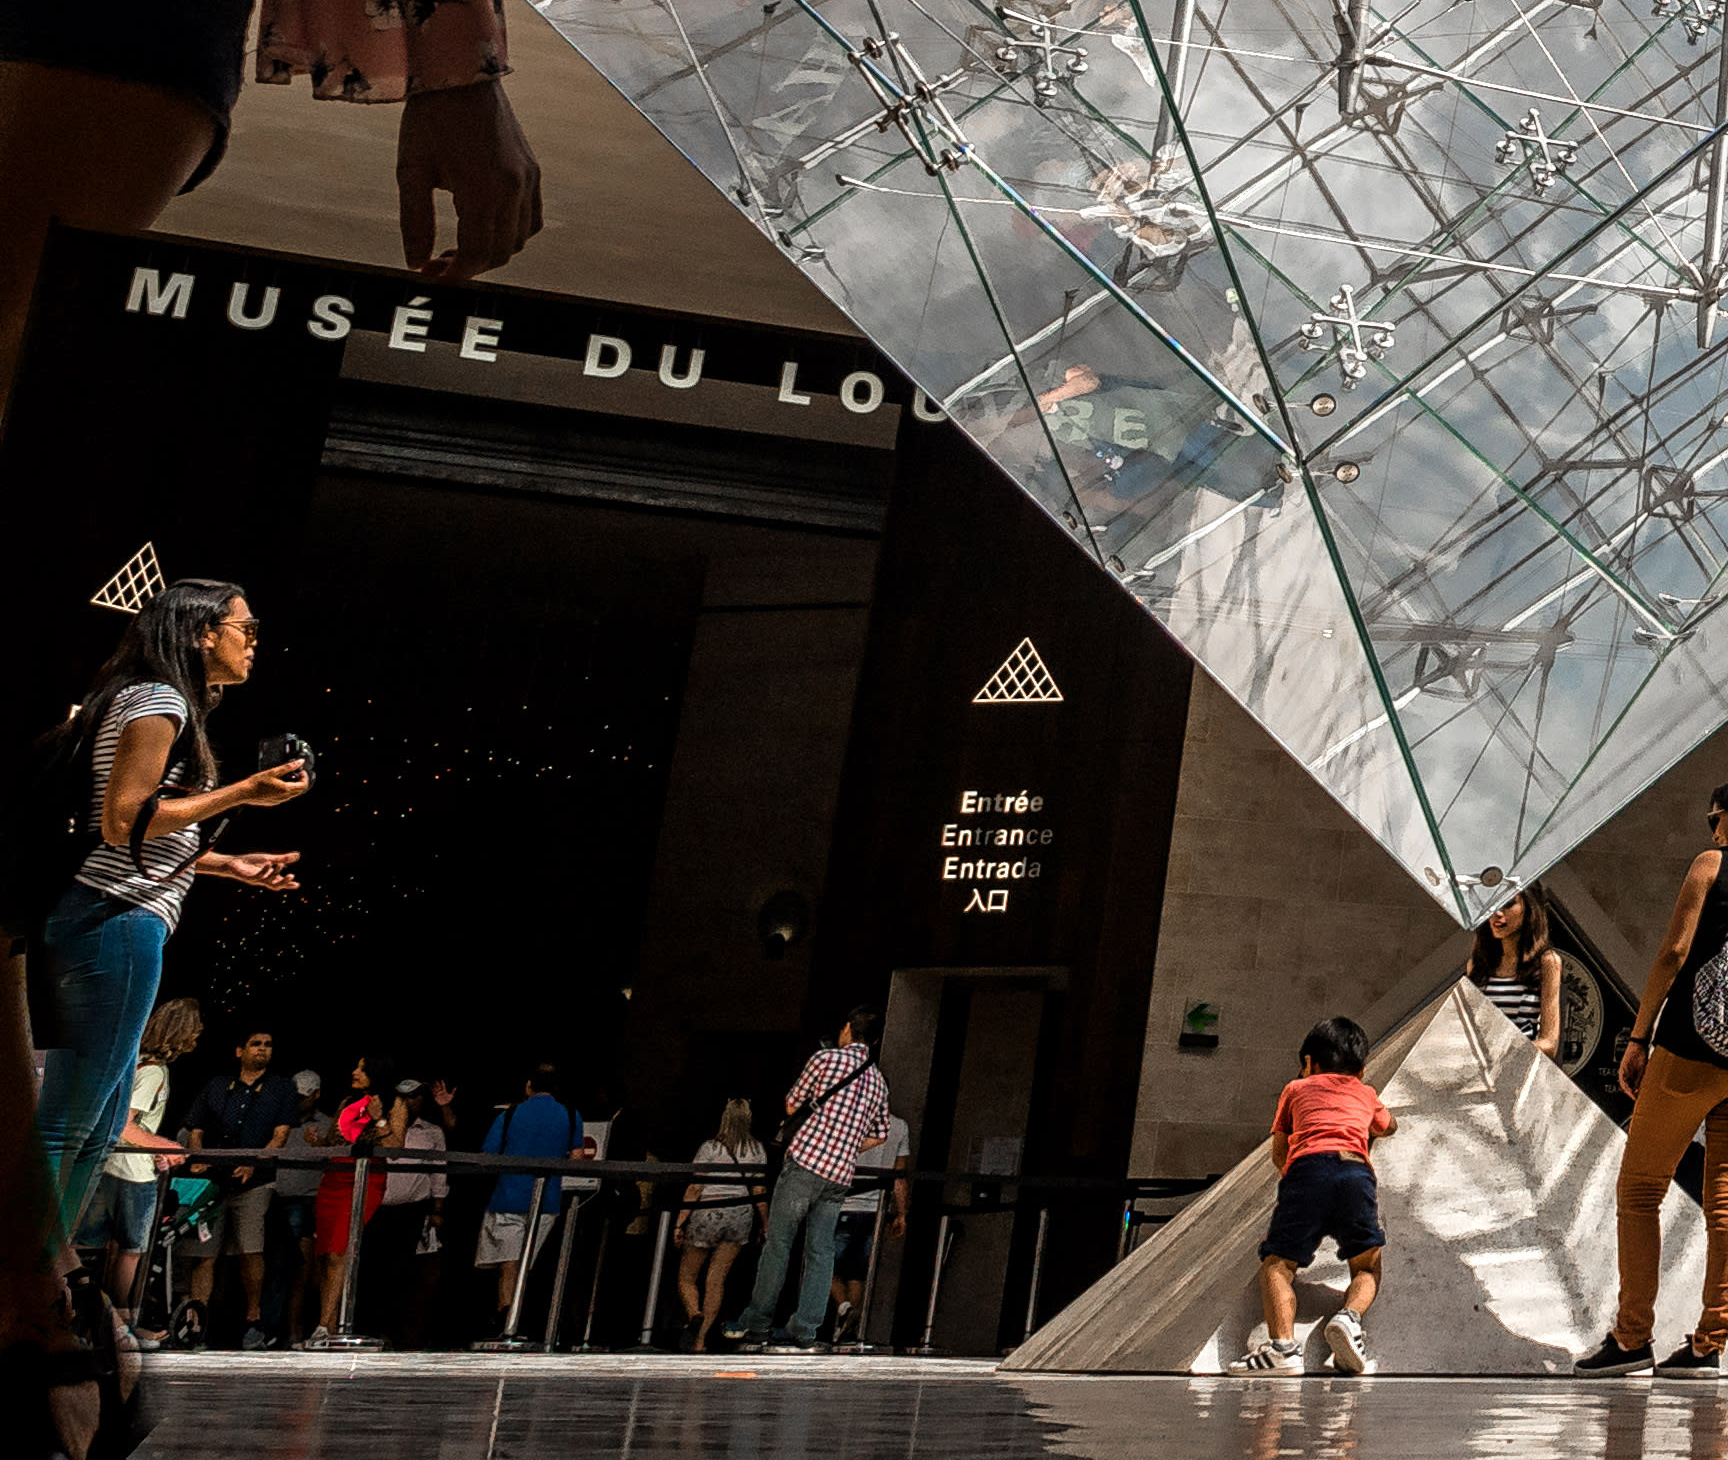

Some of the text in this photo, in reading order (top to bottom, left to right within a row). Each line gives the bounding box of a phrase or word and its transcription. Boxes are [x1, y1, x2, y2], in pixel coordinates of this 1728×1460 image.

[125, 265, 505, 363] MUSÉE
[582, 332, 706, 390] DU
[960, 789, 1044, 814] Entrée
[941, 823, 1054, 847] Entrance
[942, 855, 1042, 880] Entrada
[963, 887, 1009, 913] 入口
